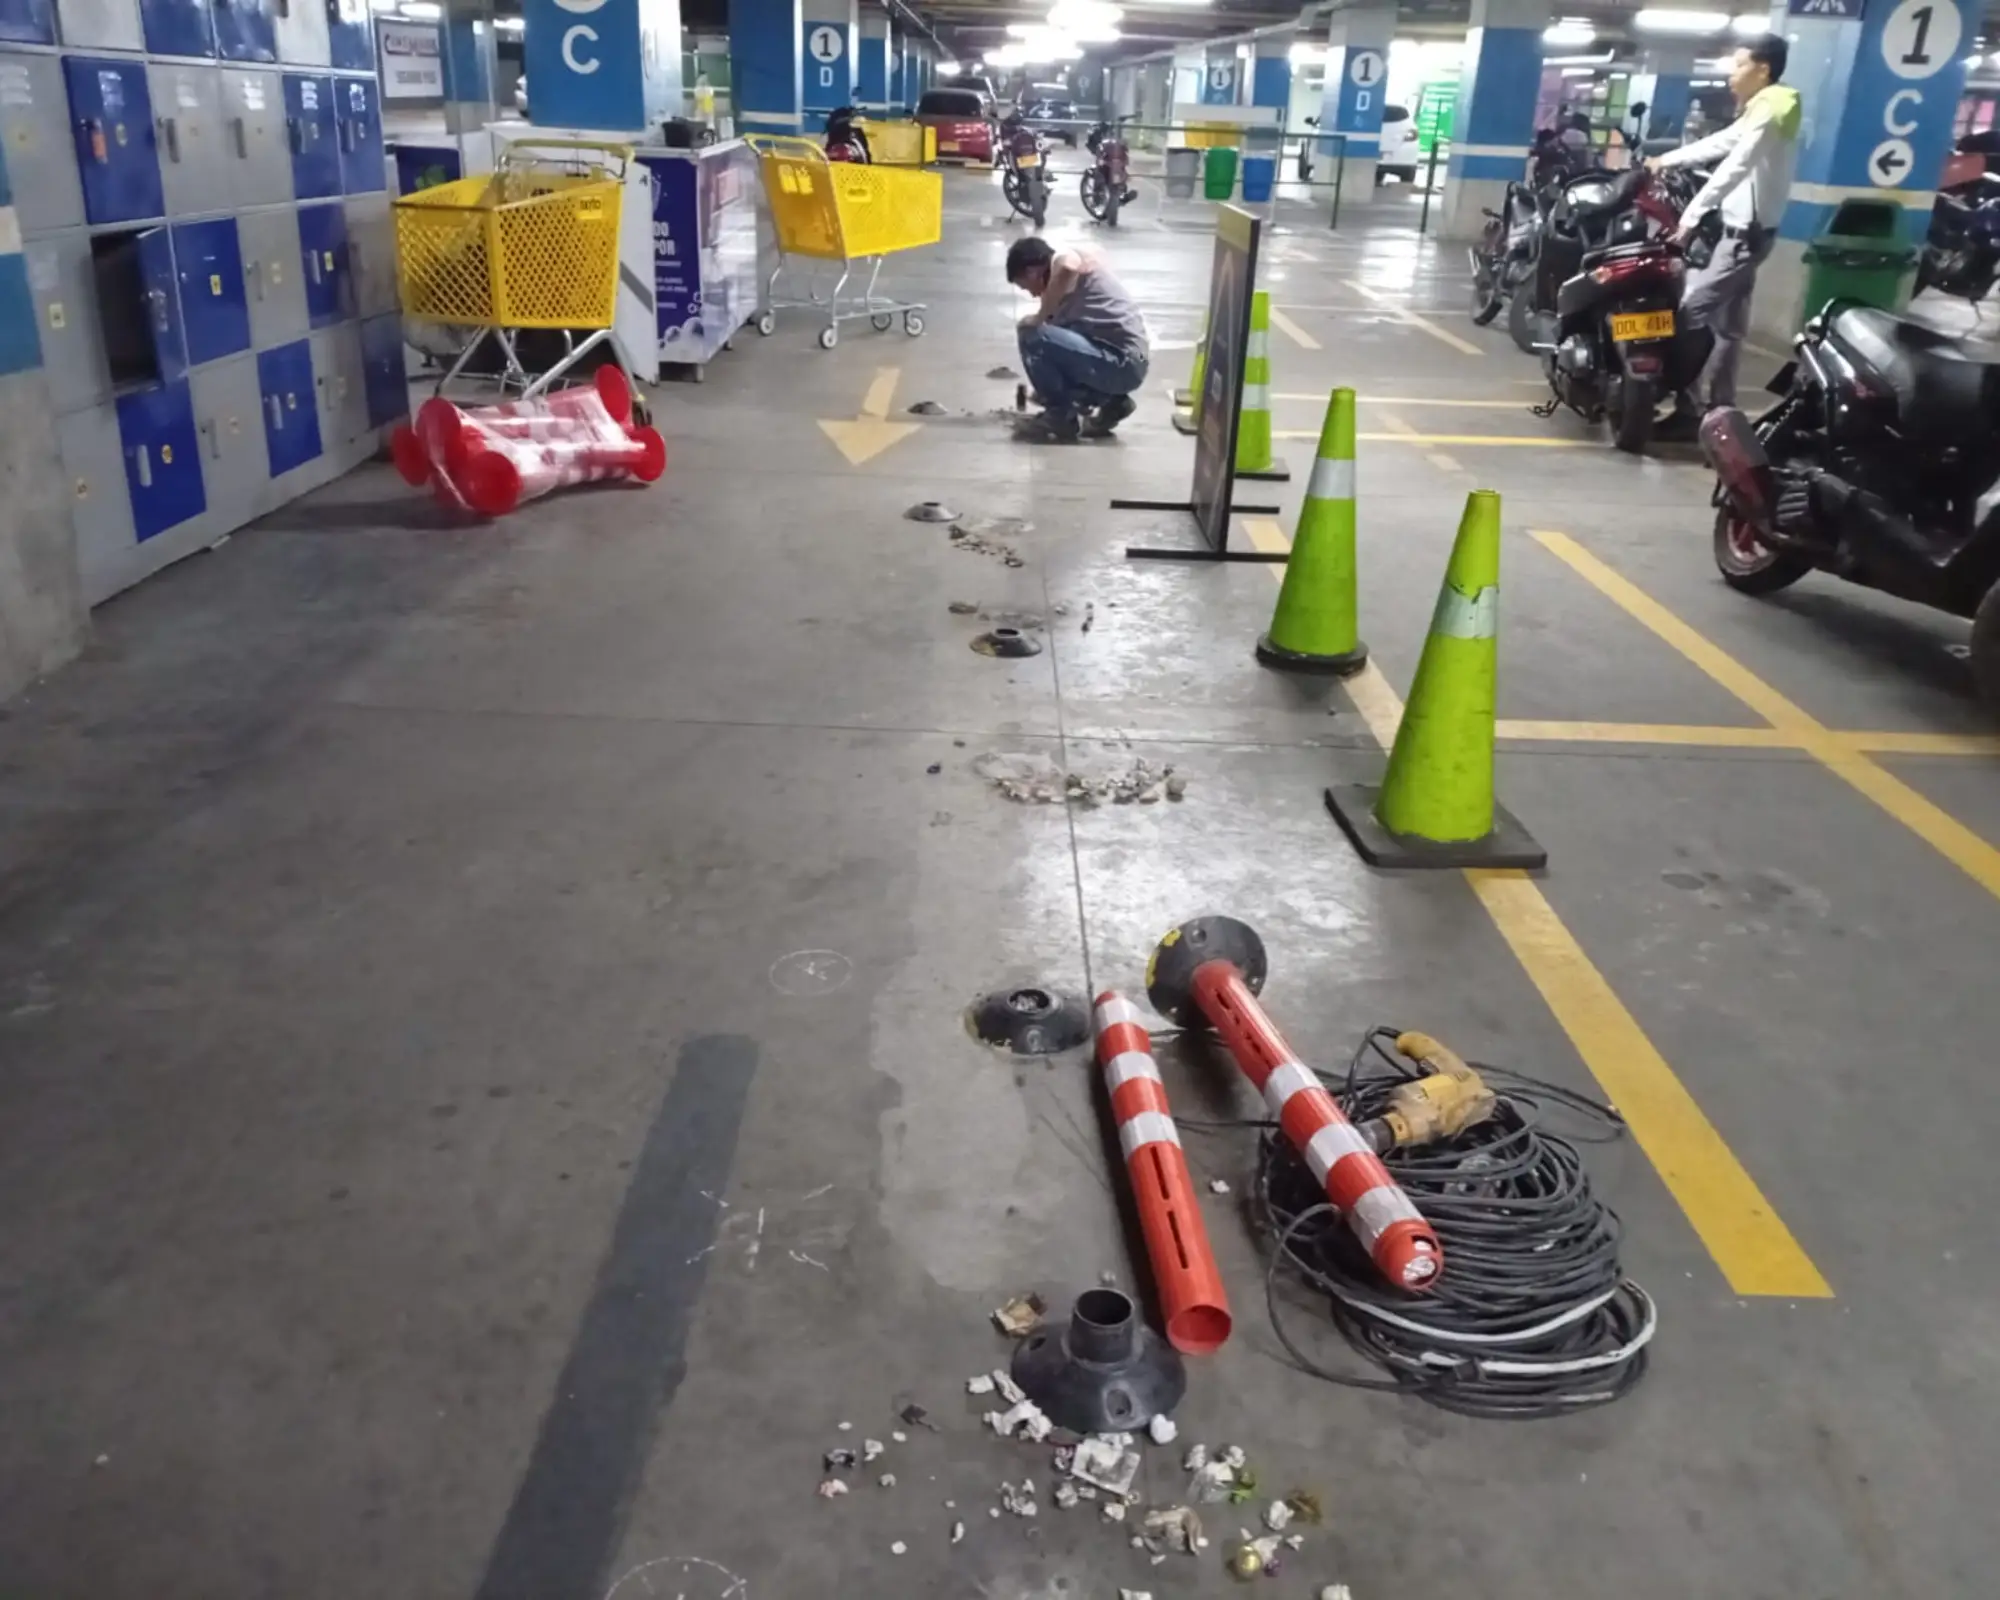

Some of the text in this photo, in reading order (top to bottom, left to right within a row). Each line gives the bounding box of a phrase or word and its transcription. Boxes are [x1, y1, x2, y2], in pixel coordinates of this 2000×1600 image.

[819, 32, 832, 57] 1
[1902, 6, 1933, 64] 1
[562, 25, 600, 74] C
[820, 66, 833, 87] D
[1358, 56, 1372, 82] 1
[1356, 91, 1371, 111] D
[1884, 89, 1923, 136] C
